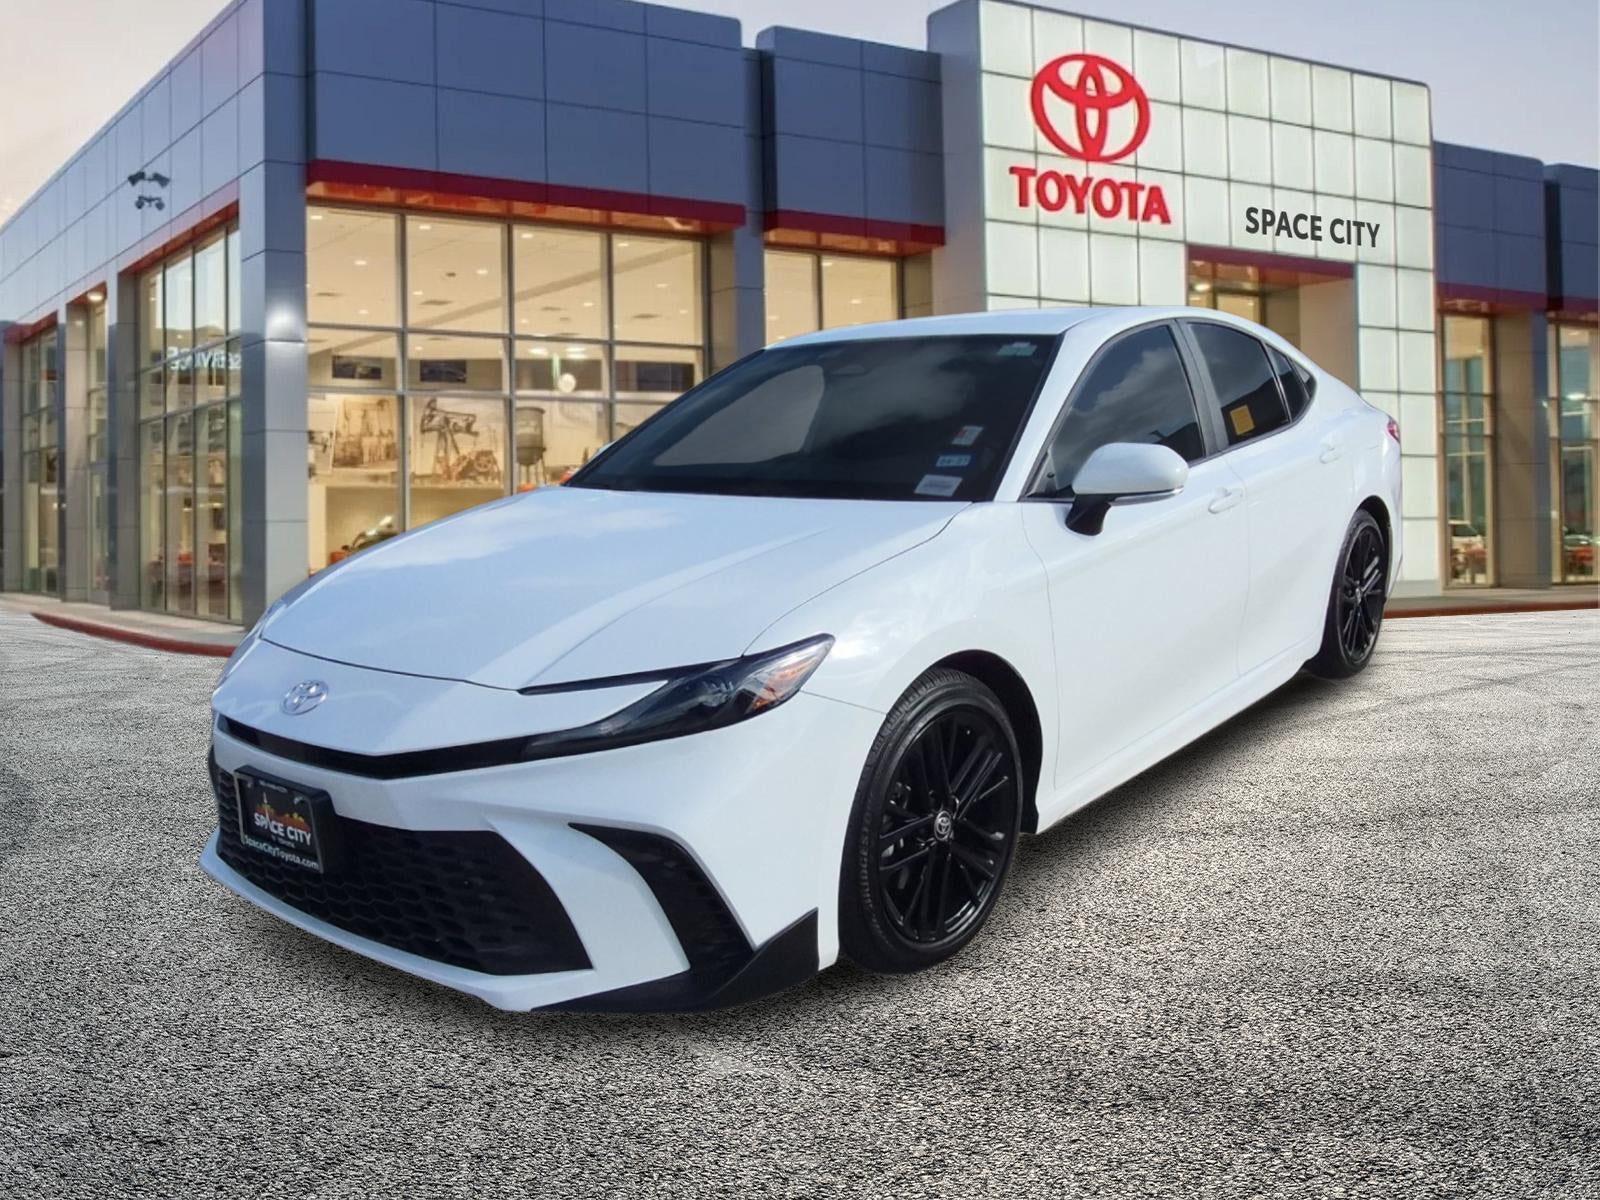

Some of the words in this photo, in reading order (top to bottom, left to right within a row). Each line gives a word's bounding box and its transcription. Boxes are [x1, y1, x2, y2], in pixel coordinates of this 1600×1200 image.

[1009, 167, 1171, 224] TOYOTA
[1245, 206, 1323, 241] SPACE
[1330, 219, 1380, 248] CITY
[254, 812, 285, 836] SPACE
[286, 826, 311, 846] CITY
[859, 790, 874, 911] BRIDGESTO
